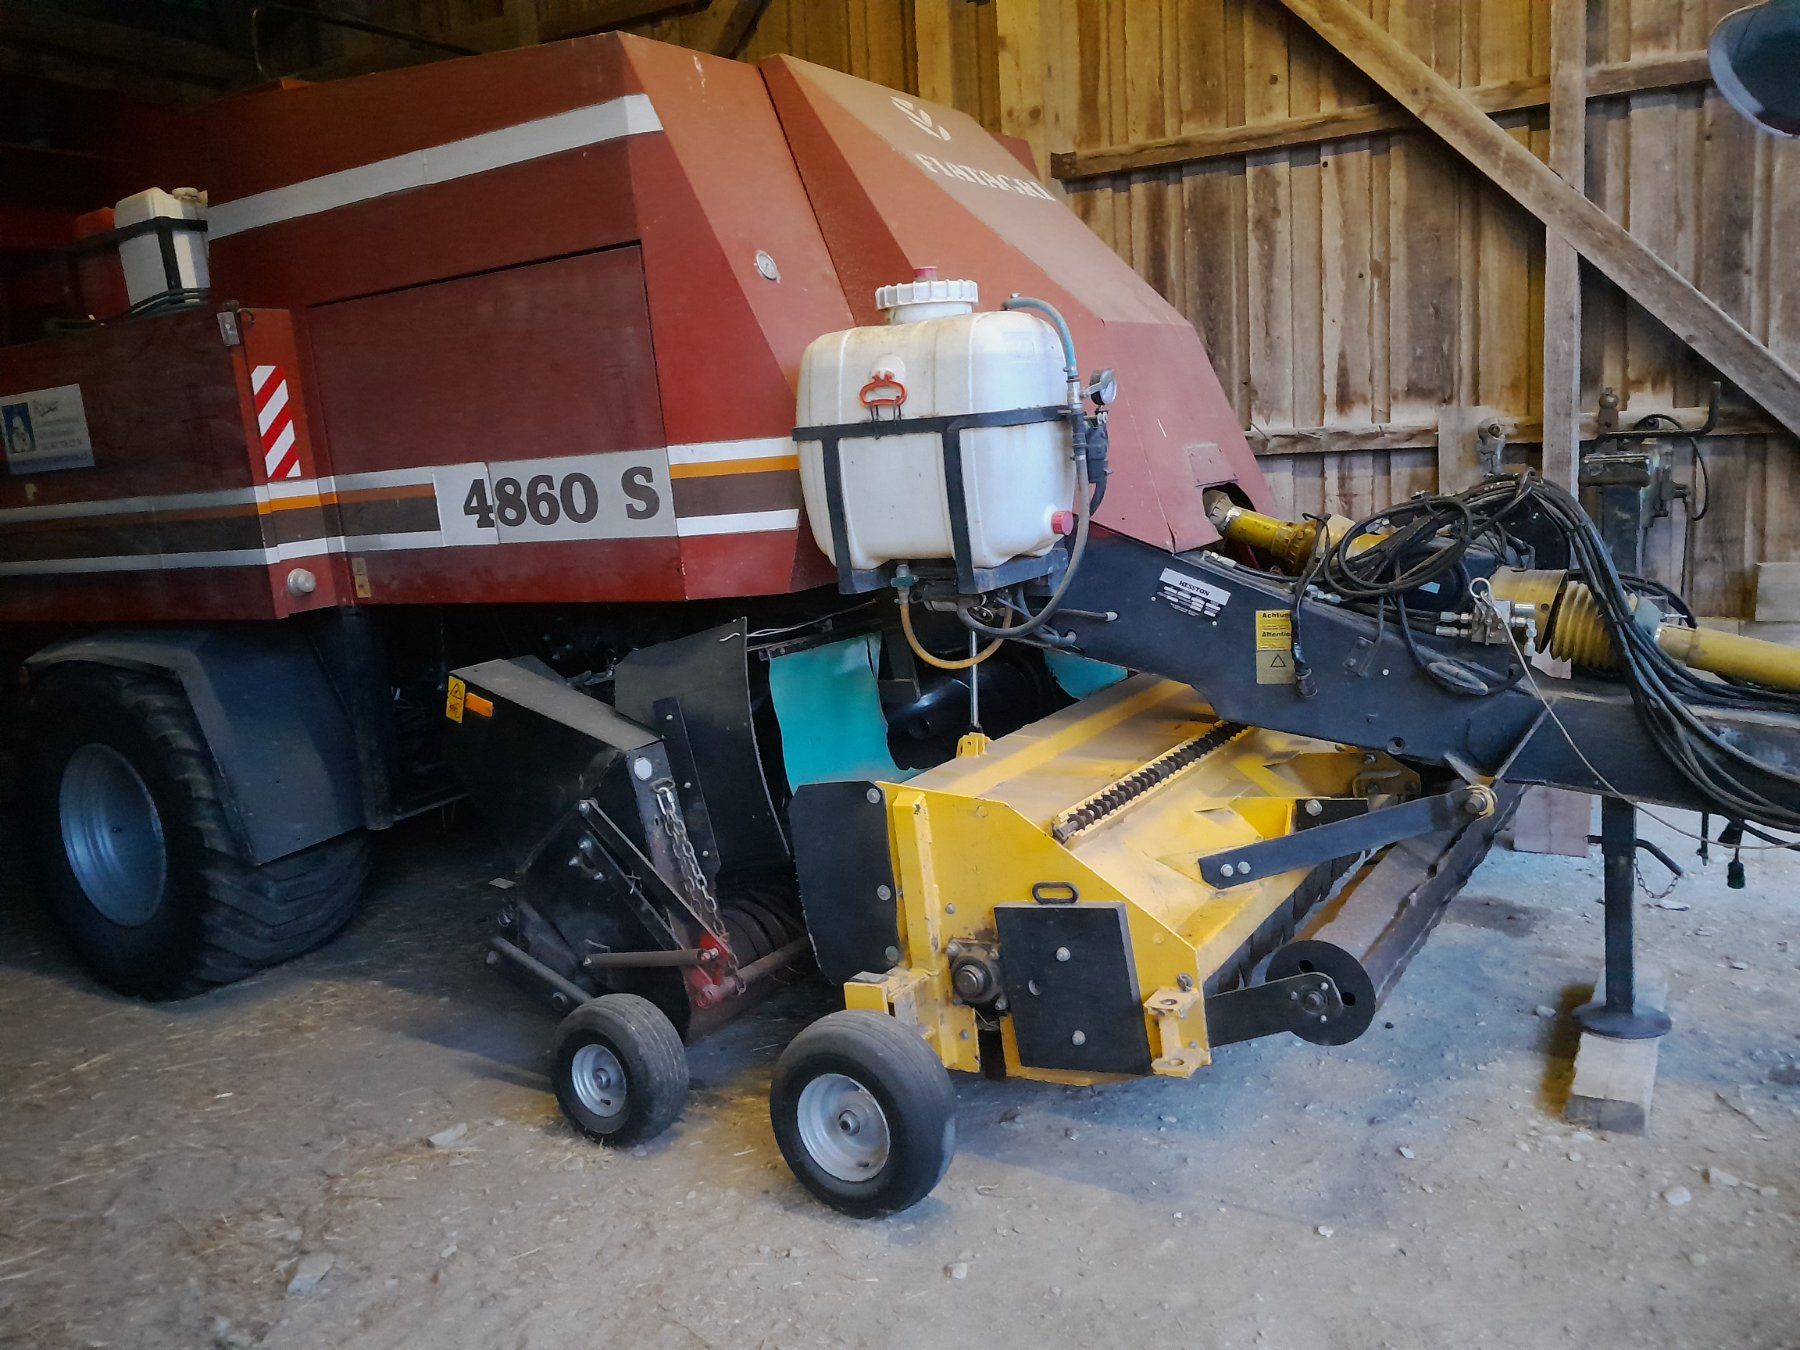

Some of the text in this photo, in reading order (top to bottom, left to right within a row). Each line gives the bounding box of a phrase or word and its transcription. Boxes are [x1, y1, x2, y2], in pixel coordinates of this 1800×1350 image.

[915, 153, 1056, 202] FIATAGRI
[463, 466, 660, 529] 4860 S
[1179, 580, 1211, 597] HESSTON
